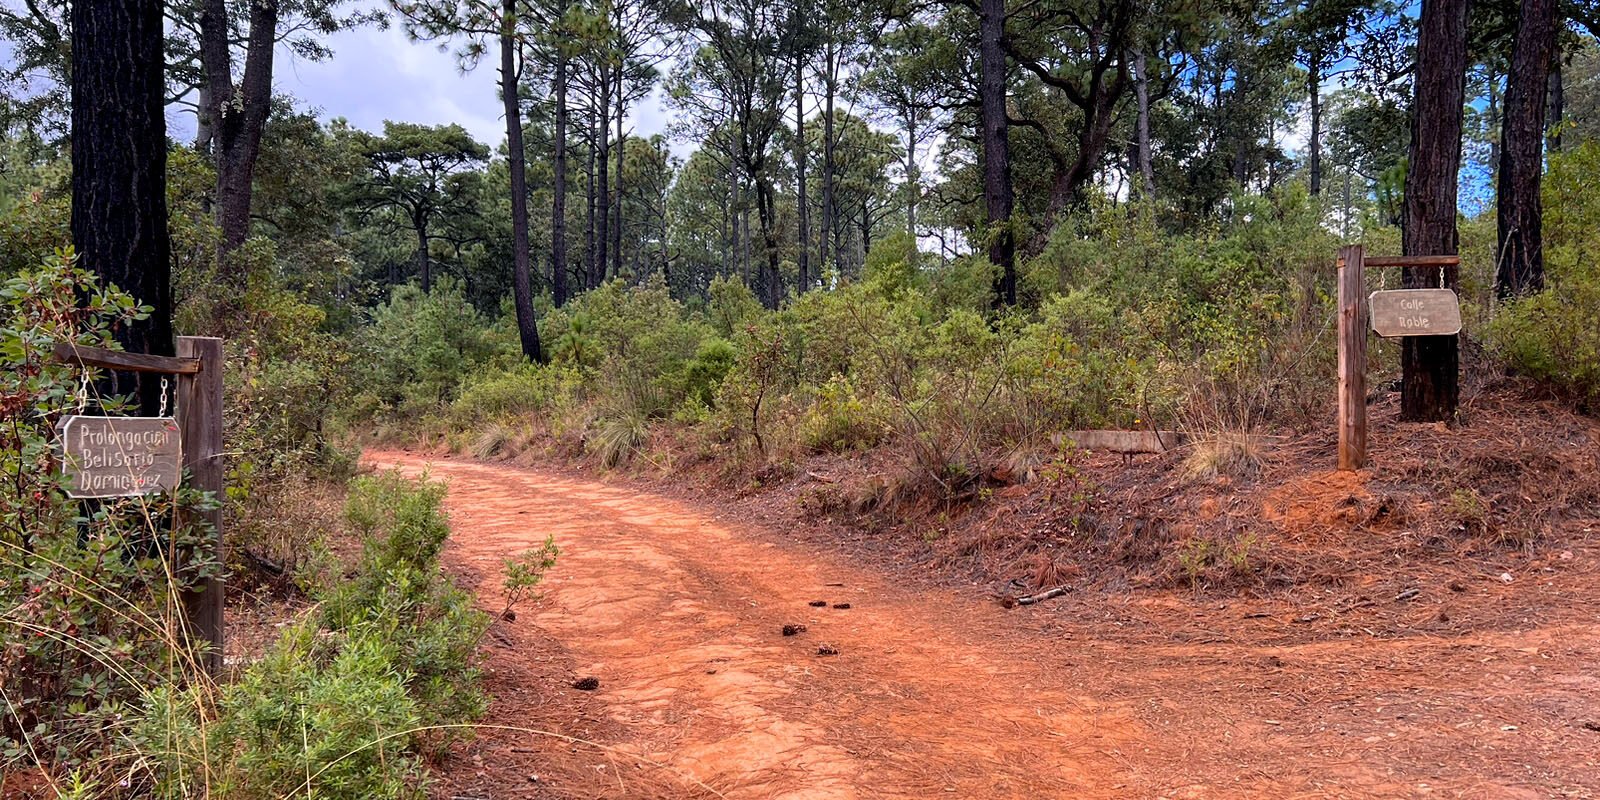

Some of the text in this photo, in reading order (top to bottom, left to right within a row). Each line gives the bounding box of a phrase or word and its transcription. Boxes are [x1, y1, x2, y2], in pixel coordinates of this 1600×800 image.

[1400, 299, 1425, 310] Calle
[1399, 316, 1430, 328] Roble
[83, 448, 154, 469] Belisario
[80, 470, 161, 491] Dominuez
